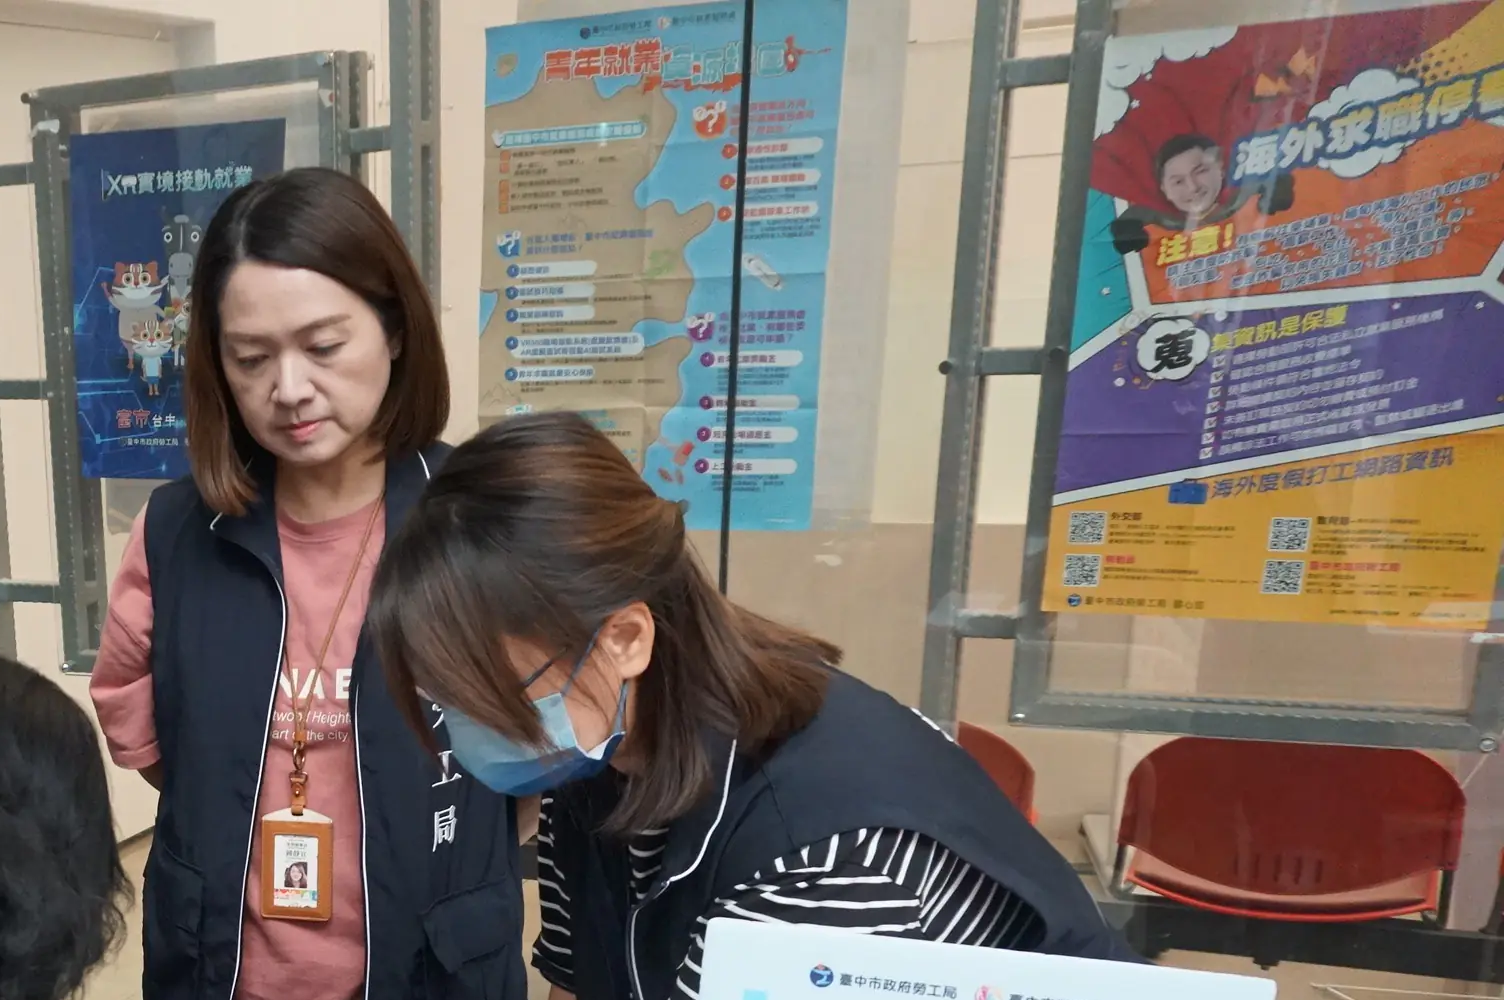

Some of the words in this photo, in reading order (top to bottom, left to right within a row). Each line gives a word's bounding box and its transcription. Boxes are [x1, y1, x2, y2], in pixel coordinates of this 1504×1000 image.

[1212, 446, 1454, 499] 海外度假打工網路資訊
[839, 972, 958, 1000] 臺中市政府勞工局
